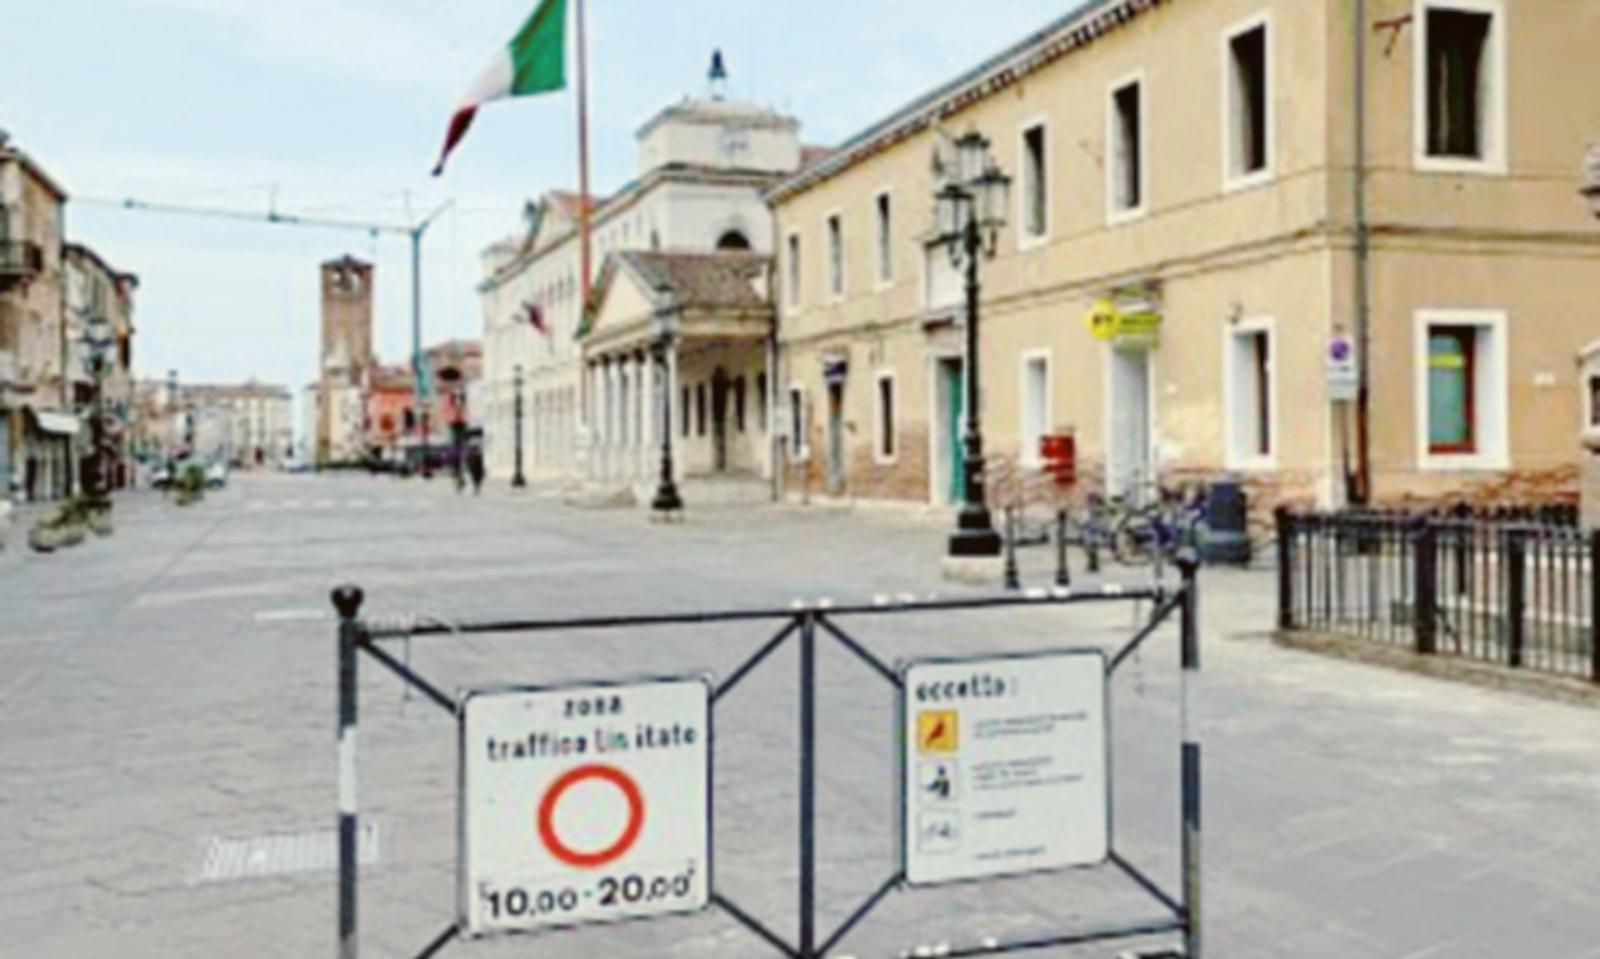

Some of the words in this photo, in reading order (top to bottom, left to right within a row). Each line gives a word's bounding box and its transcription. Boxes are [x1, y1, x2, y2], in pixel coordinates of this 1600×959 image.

[563, 696, 623, 717] zona
[487, 732, 588, 761] traffico
[594, 722, 697, 752] limitato
